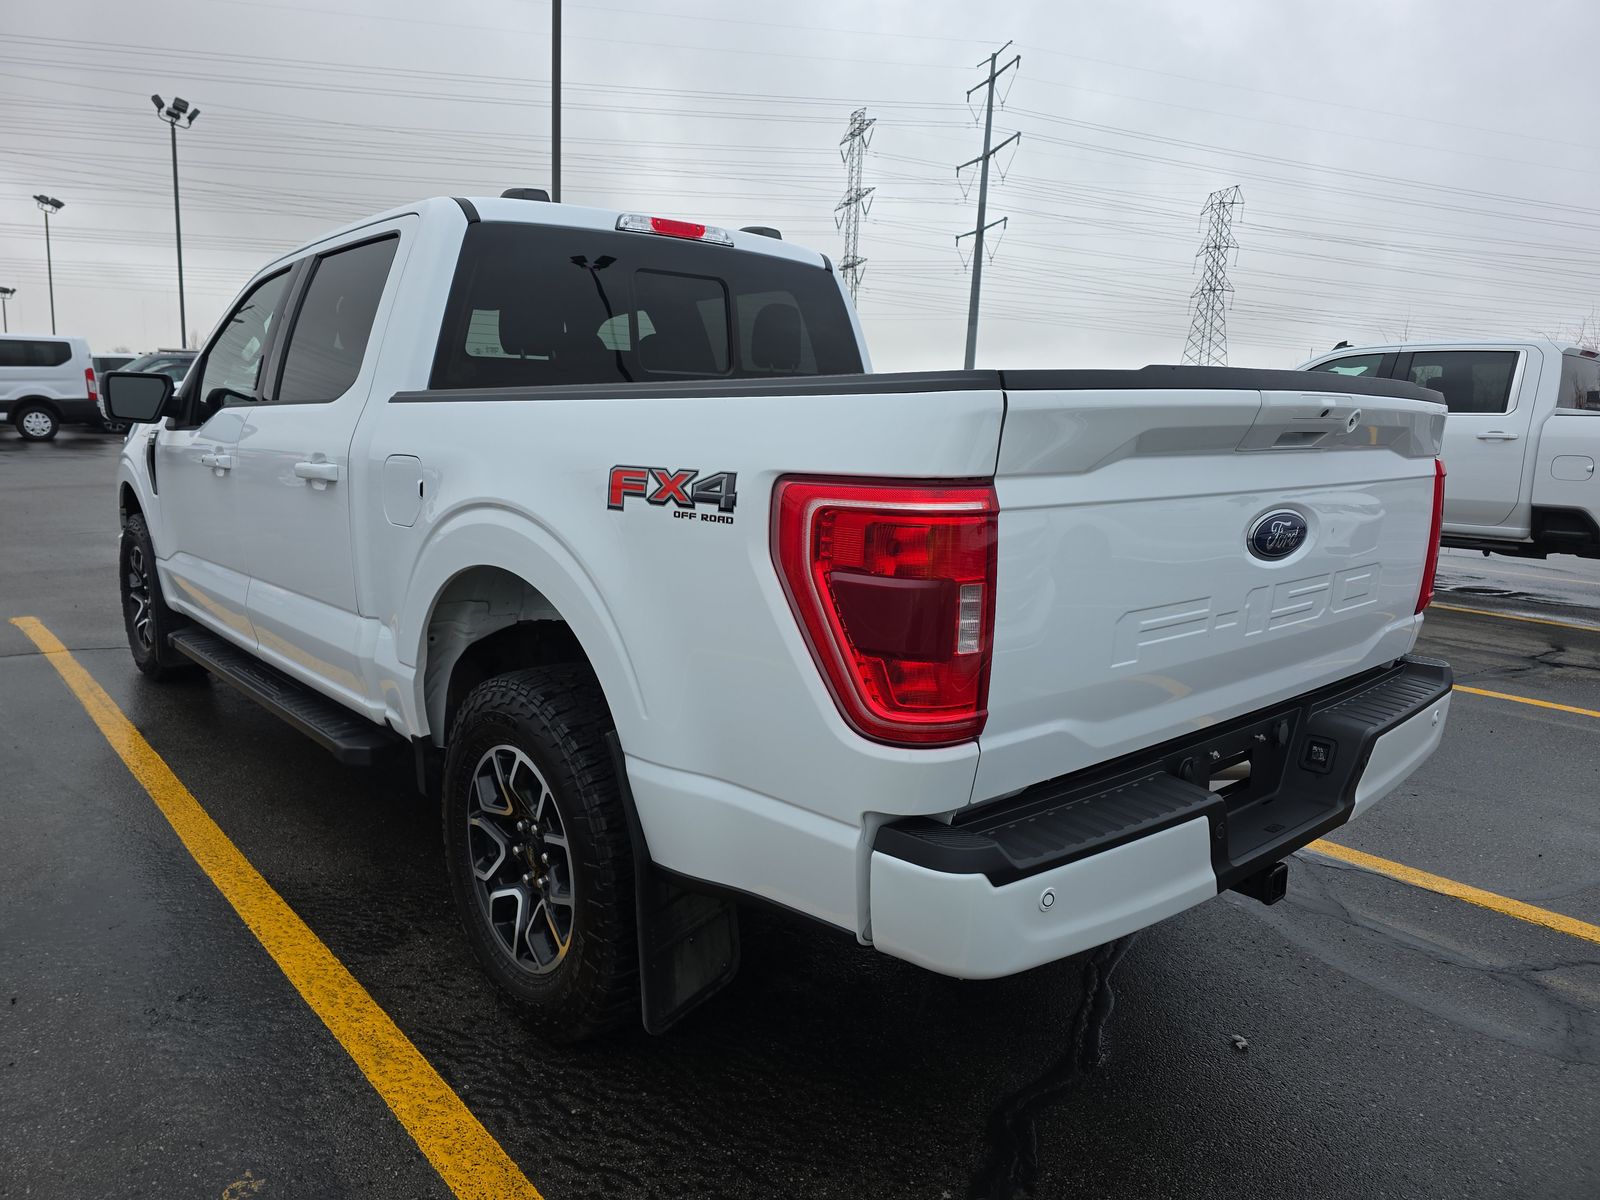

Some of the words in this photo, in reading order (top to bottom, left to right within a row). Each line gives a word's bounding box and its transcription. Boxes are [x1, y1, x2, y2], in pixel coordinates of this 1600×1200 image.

[607, 464, 738, 513] FX4
[673, 510, 697, 520] OFF
[700, 513, 733, 524] ROAD
[1266, 520, 1300, 550] Ford
[1110, 561, 1382, 668] F-150
